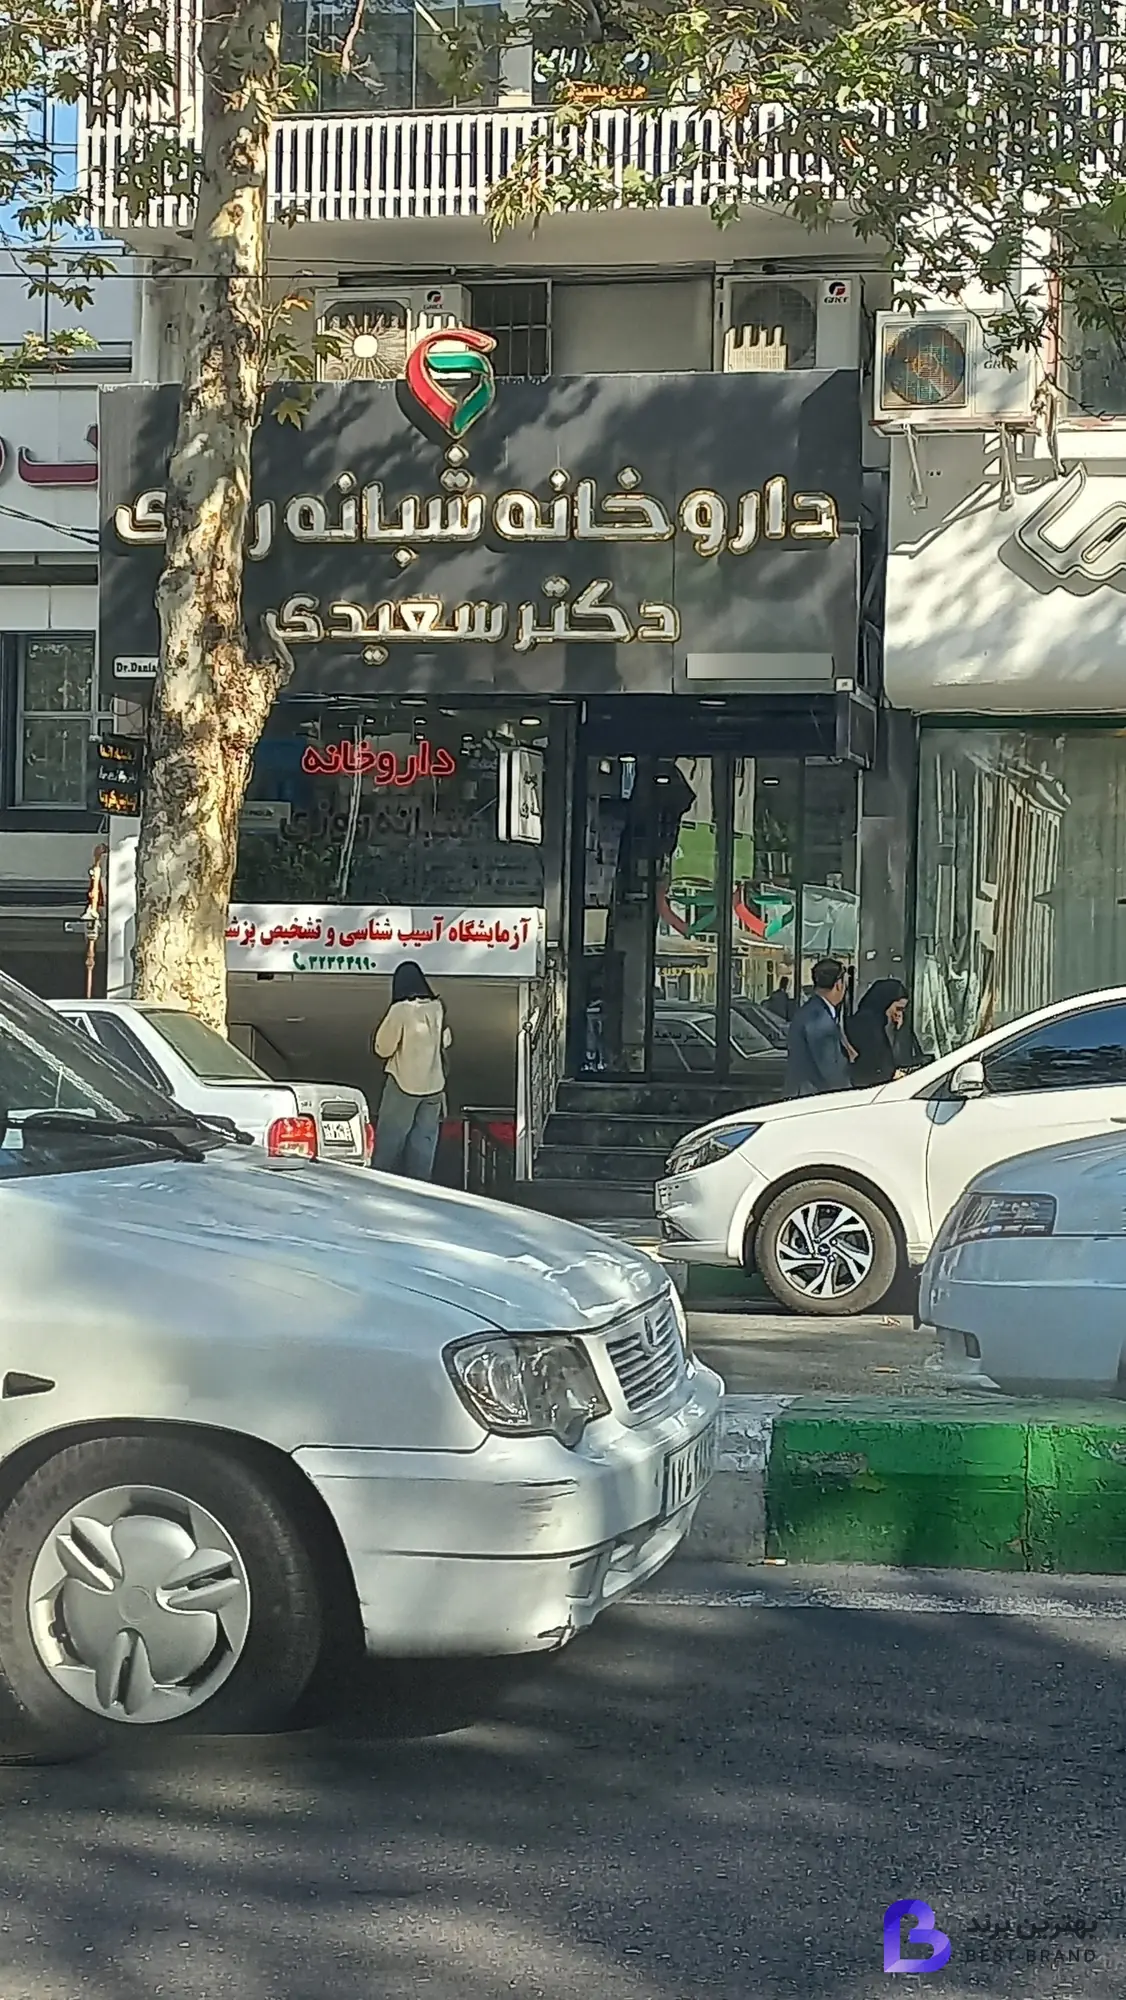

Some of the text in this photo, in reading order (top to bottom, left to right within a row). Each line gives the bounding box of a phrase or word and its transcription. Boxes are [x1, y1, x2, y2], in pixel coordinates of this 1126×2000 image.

[114, 445, 840, 569] داروخانه شبانه ری
[262, 576, 682, 665] دکتر سعیدی
[302, 740, 455, 785] داروخانه
[224, 915, 532, 950] آزمایشگاه آسیب شناسی و تشخیص پزش
